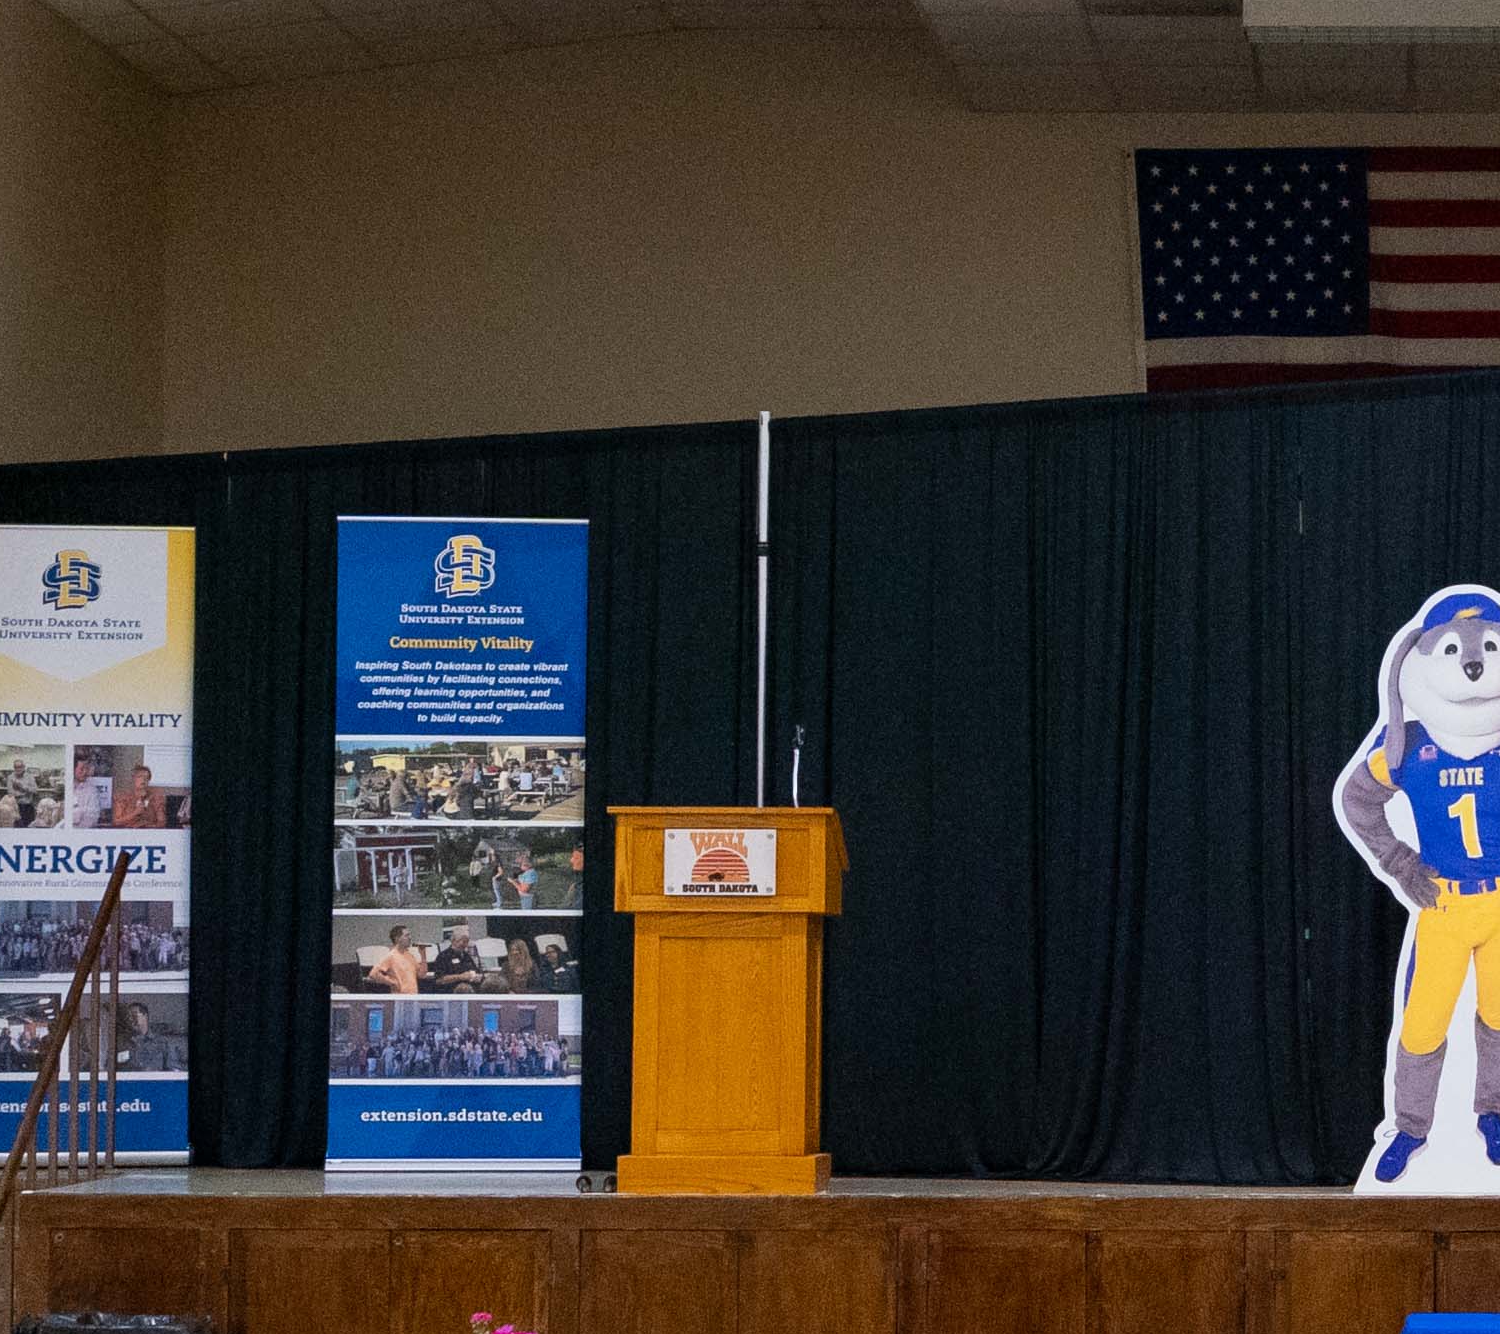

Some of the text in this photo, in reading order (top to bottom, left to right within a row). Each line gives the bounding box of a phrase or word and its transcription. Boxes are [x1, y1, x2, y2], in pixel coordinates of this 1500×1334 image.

[1, 617, 142, 628] SOUTH DAKOTA STATE
[0, 629, 144, 641] UNIVERSITY EXTENSION
[389, 636, 534, 652] Community Vitality
[355, 661, 568, 672] Inspiring South Dakotans to create vibrant
[360, 674, 562, 685] communities by facilitating connections,
[372, 687, 551, 698] offering learning opportunities, and
[357, 700, 564, 712] coaching communities and organizations
[91, 713, 182, 728] VITALITY
[417, 713, 504, 724] to build capacity.
[1439, 767, 1484, 787] STATE
[1448, 793, 1484, 859] 1
[690, 832, 748, 859] WALL
[682, 884, 758, 893] SOUTH DAKOTA
[360, 1108, 543, 1122] extension.sdstate.edu
